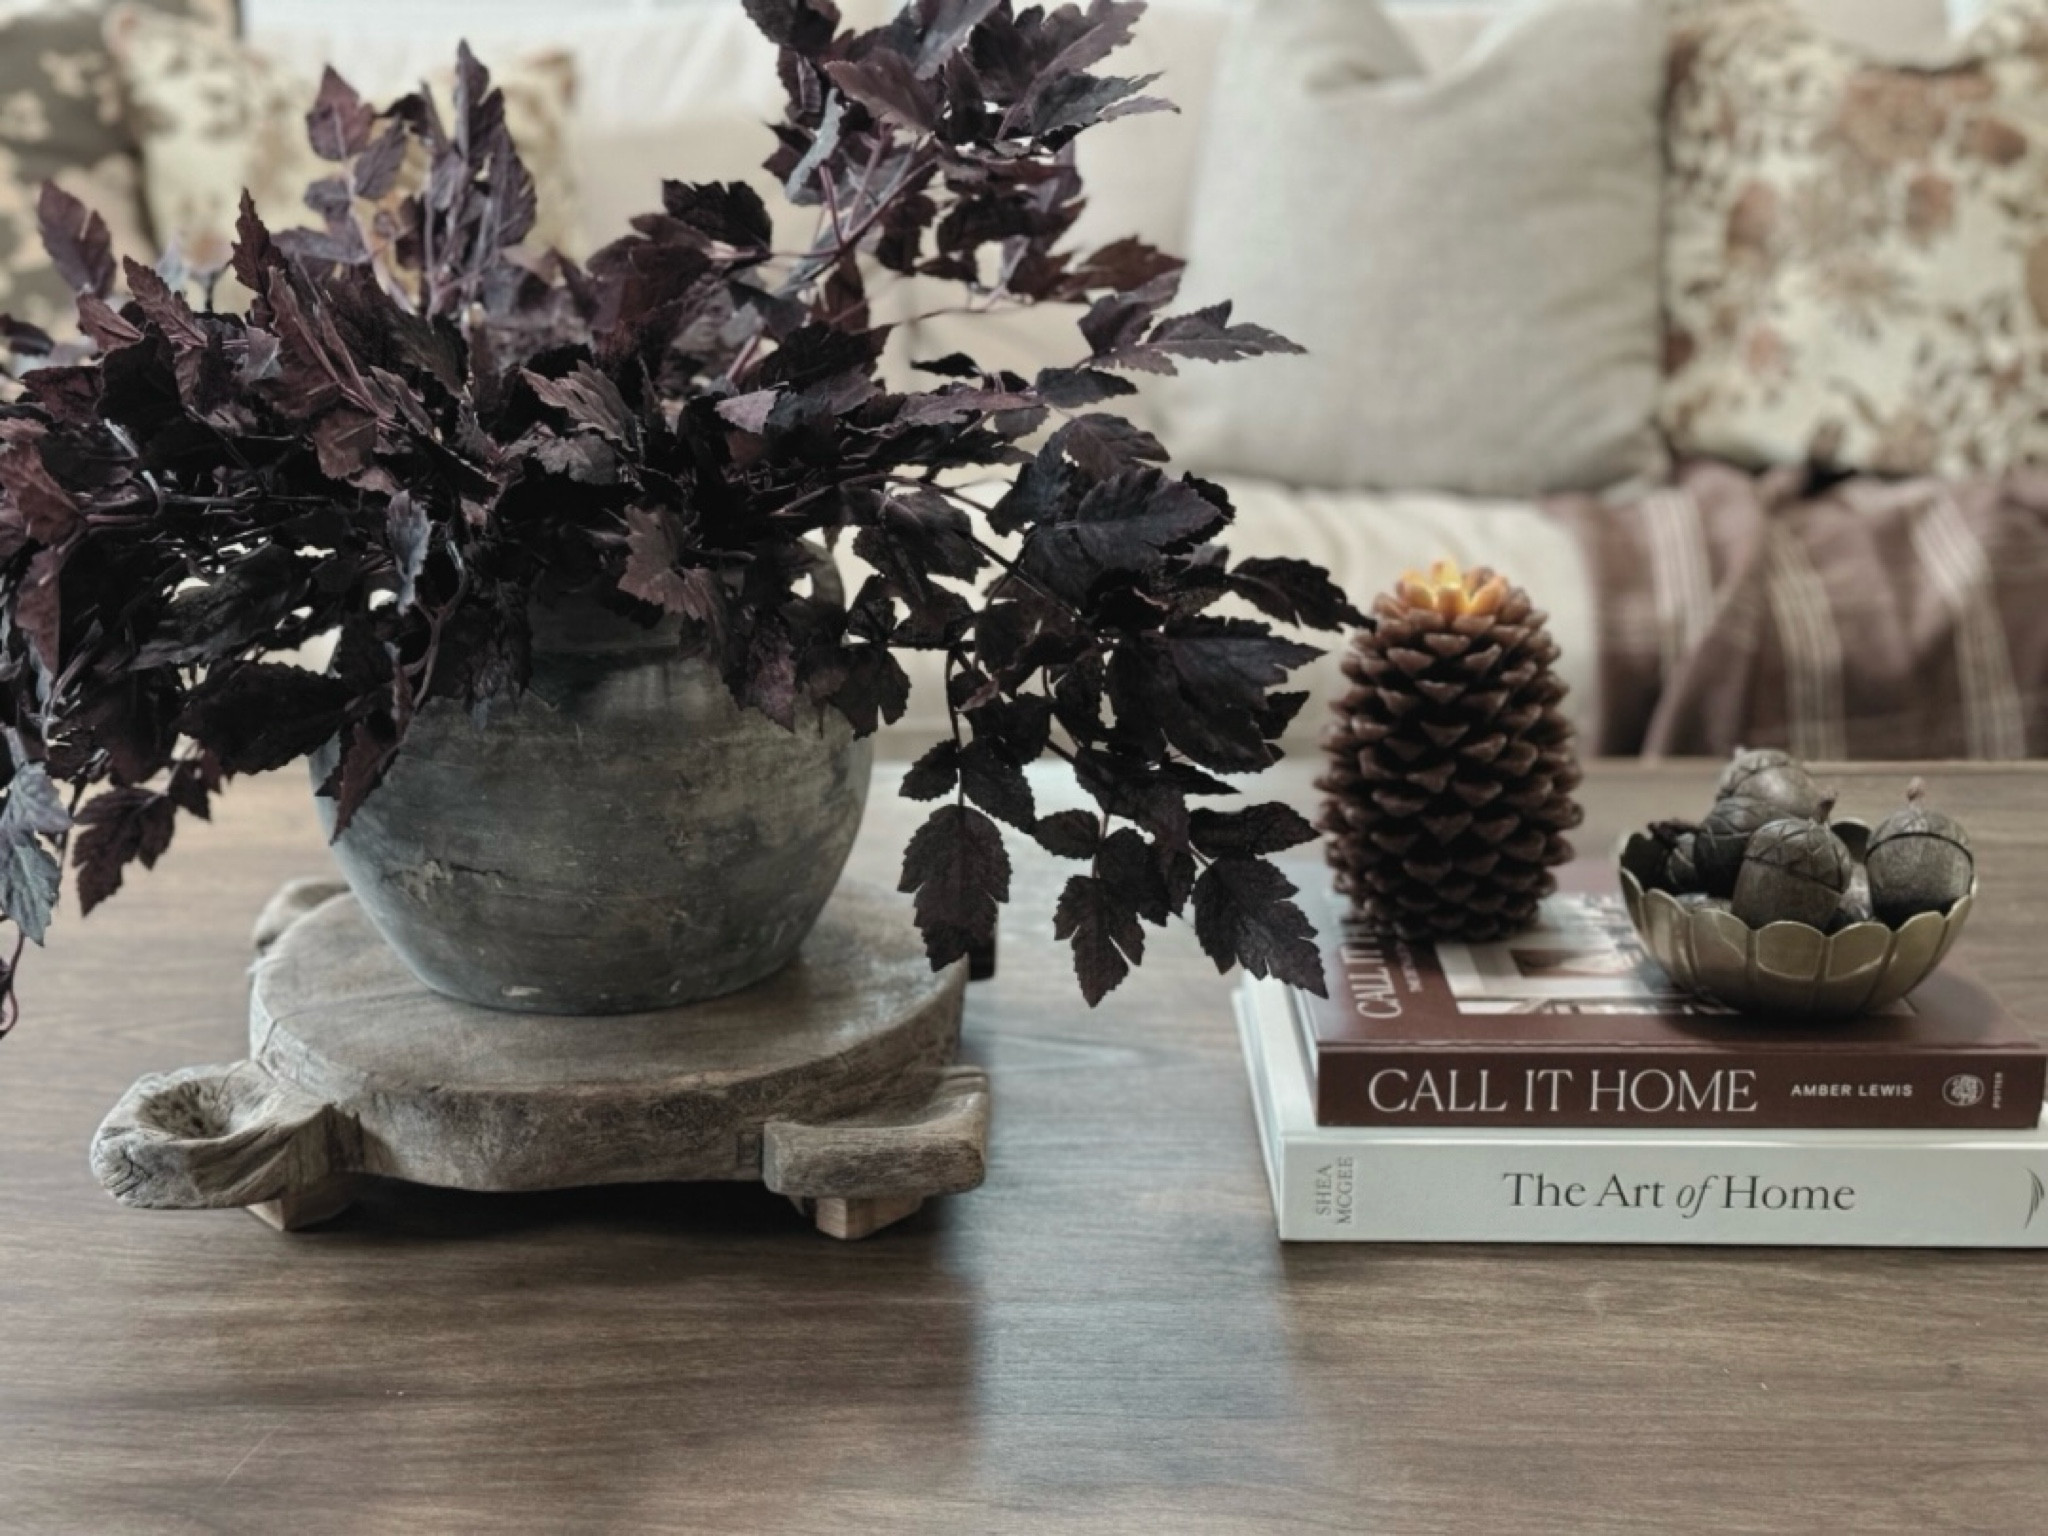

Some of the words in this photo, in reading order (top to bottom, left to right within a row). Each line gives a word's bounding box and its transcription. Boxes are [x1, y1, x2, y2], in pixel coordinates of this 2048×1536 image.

[1347, 966, 1402, 1019] CALL
[1368, 1068, 1508, 1113] CALL
[1523, 1068, 1573, 1112] IT
[1588, 1068, 1759, 1113] HOME
[1790, 1083, 1852, 1097] AMBER
[1857, 1083, 1914, 1097] LEWIS
[1315, 1164, 1332, 1216] SHEA
[1336, 1156, 1353, 1225] MCGEE
[1502, 1172, 1587, 1208] The
[1594, 1172, 1665, 1208] Art
[1675, 1175, 1719, 1219] of
[1721, 1174, 1856, 1211] Home
